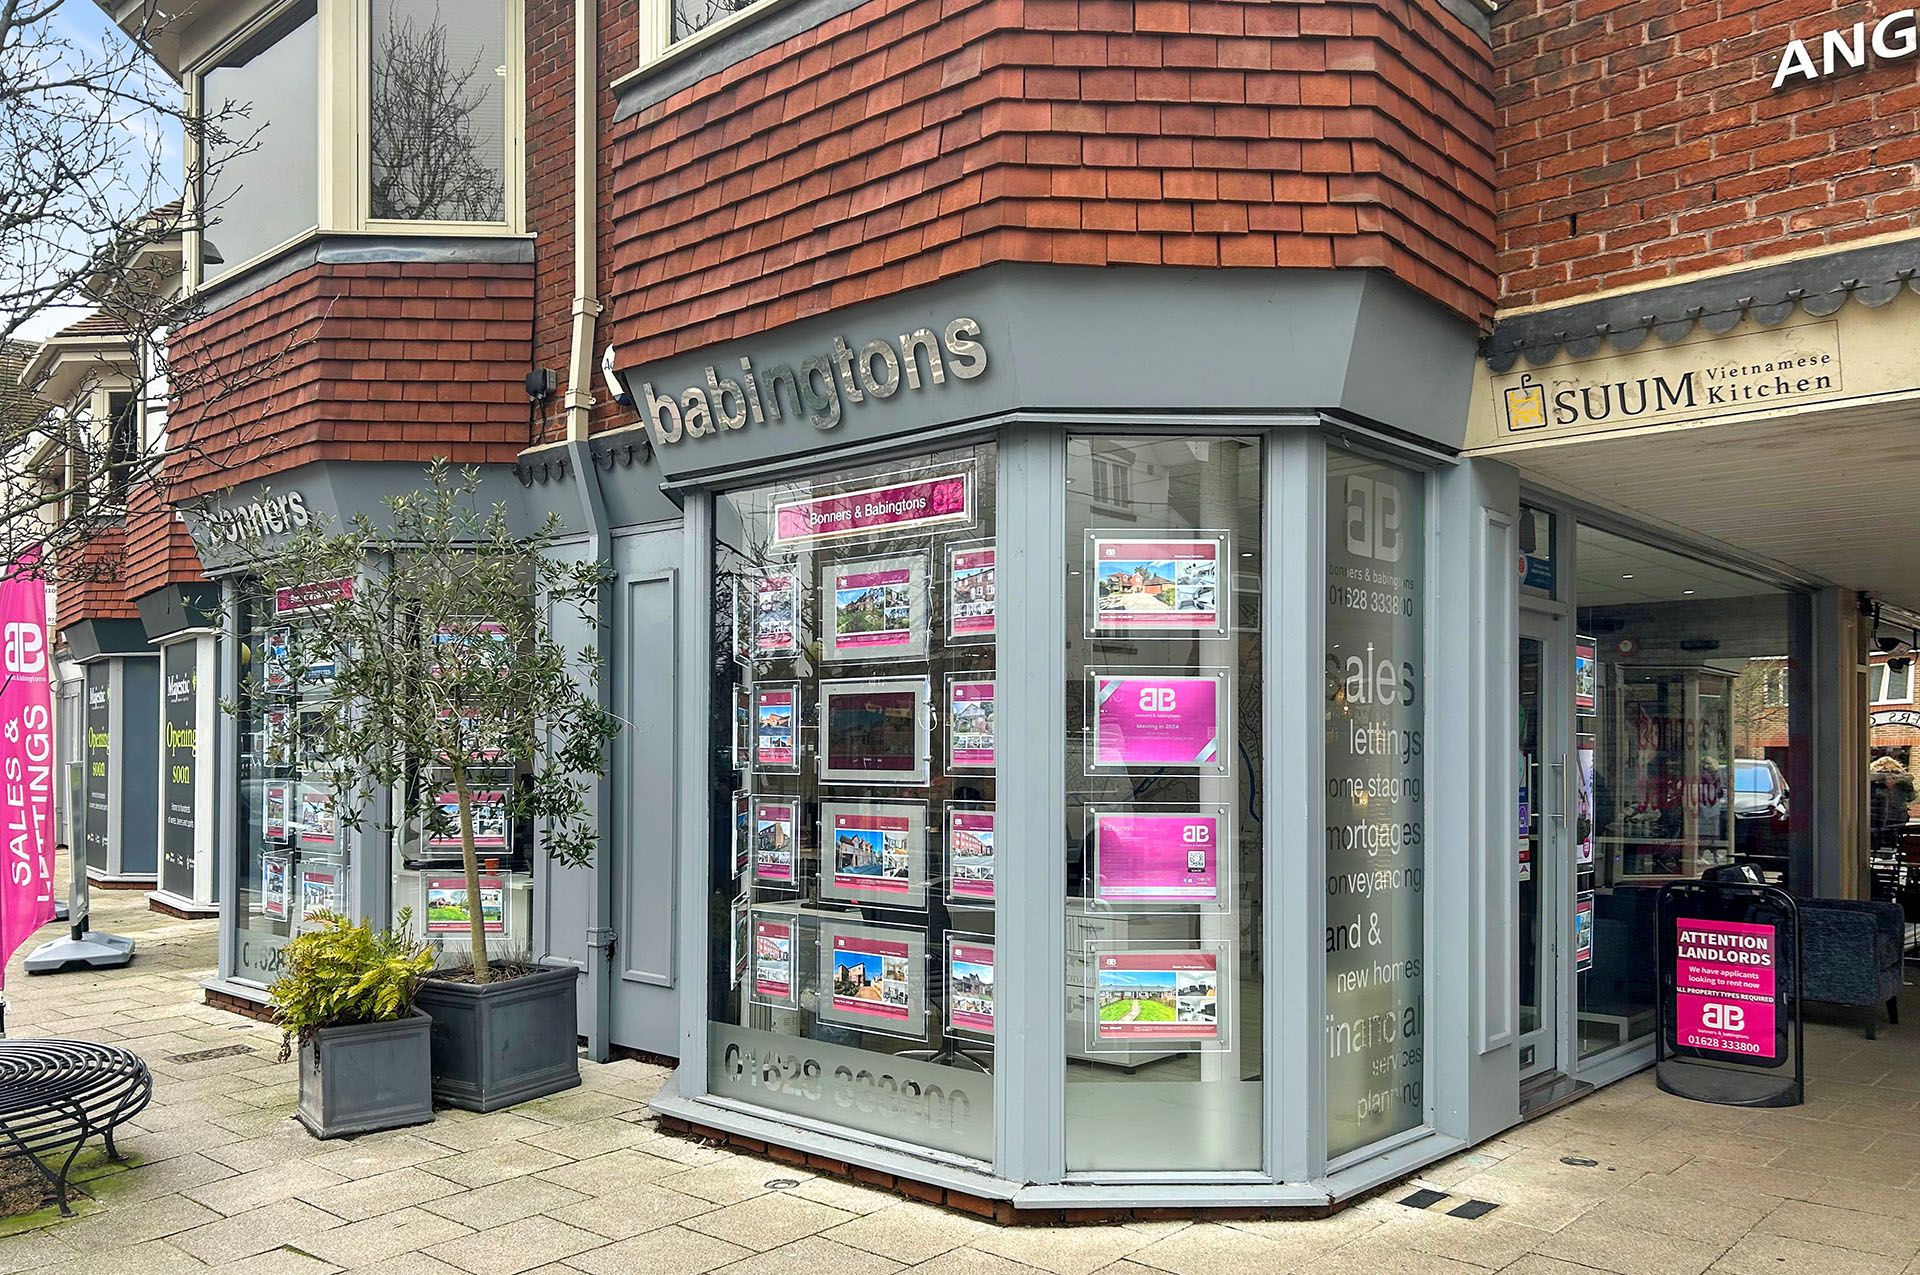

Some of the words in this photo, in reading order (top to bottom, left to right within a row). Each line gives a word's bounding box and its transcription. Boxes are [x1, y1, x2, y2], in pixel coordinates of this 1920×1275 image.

[1771, 9, 1918, 90] ANG
[1705, 352, 1832, 380] Vietnamese
[642, 317, 989, 445] babingtons
[1555, 371, 1697, 425] SUUM
[1707, 374, 1832, 404] Kitchen
[810, 509, 852, 526] Bonners
[855, 506, 862, 519] &
[864, 497, 926, 517] Babingtons
[1364, 568, 1371, 582] &
[1329, 584, 1367, 610] 01628
[167, 674, 190, 699] Majestic
[4, 716, 19, 744] &
[166, 721, 197, 758] Opening
[1136, 723, 1158, 731] Moving
[1349, 718, 1421, 765] lettings
[172, 764, 190, 784] soon
[1326, 777, 1363, 798] ome
[1367, 772, 1421, 804] staging
[5, 757, 32, 887] SALES
[1326, 818, 1421, 856] mortgages
[1327, 864, 1421, 899] onveyancing
[1368, 912, 1382, 946] &
[1680, 931, 1768, 950] ATTENTION
[1678, 946, 1771, 966] LANDLORDS
[1337, 968, 1369, 993] new
[1373, 959, 1421, 986] homes
[1688, 975, 1716, 985] looking
[1701, 966, 1719, 975] have
[1720, 970, 1760, 979] applicants
[1687, 987, 1720, 997] PROPERTY
[1720, 991, 1740, 999] TYPES
[1740, 993, 1774, 1003] REQUIRED
[1326, 995, 1421, 1059] inancial
[1688, 1035, 1719, 1047] 01628
[1721, 1040, 1760, 1053] 333800
[725, 1043, 822, 1101] 01628
